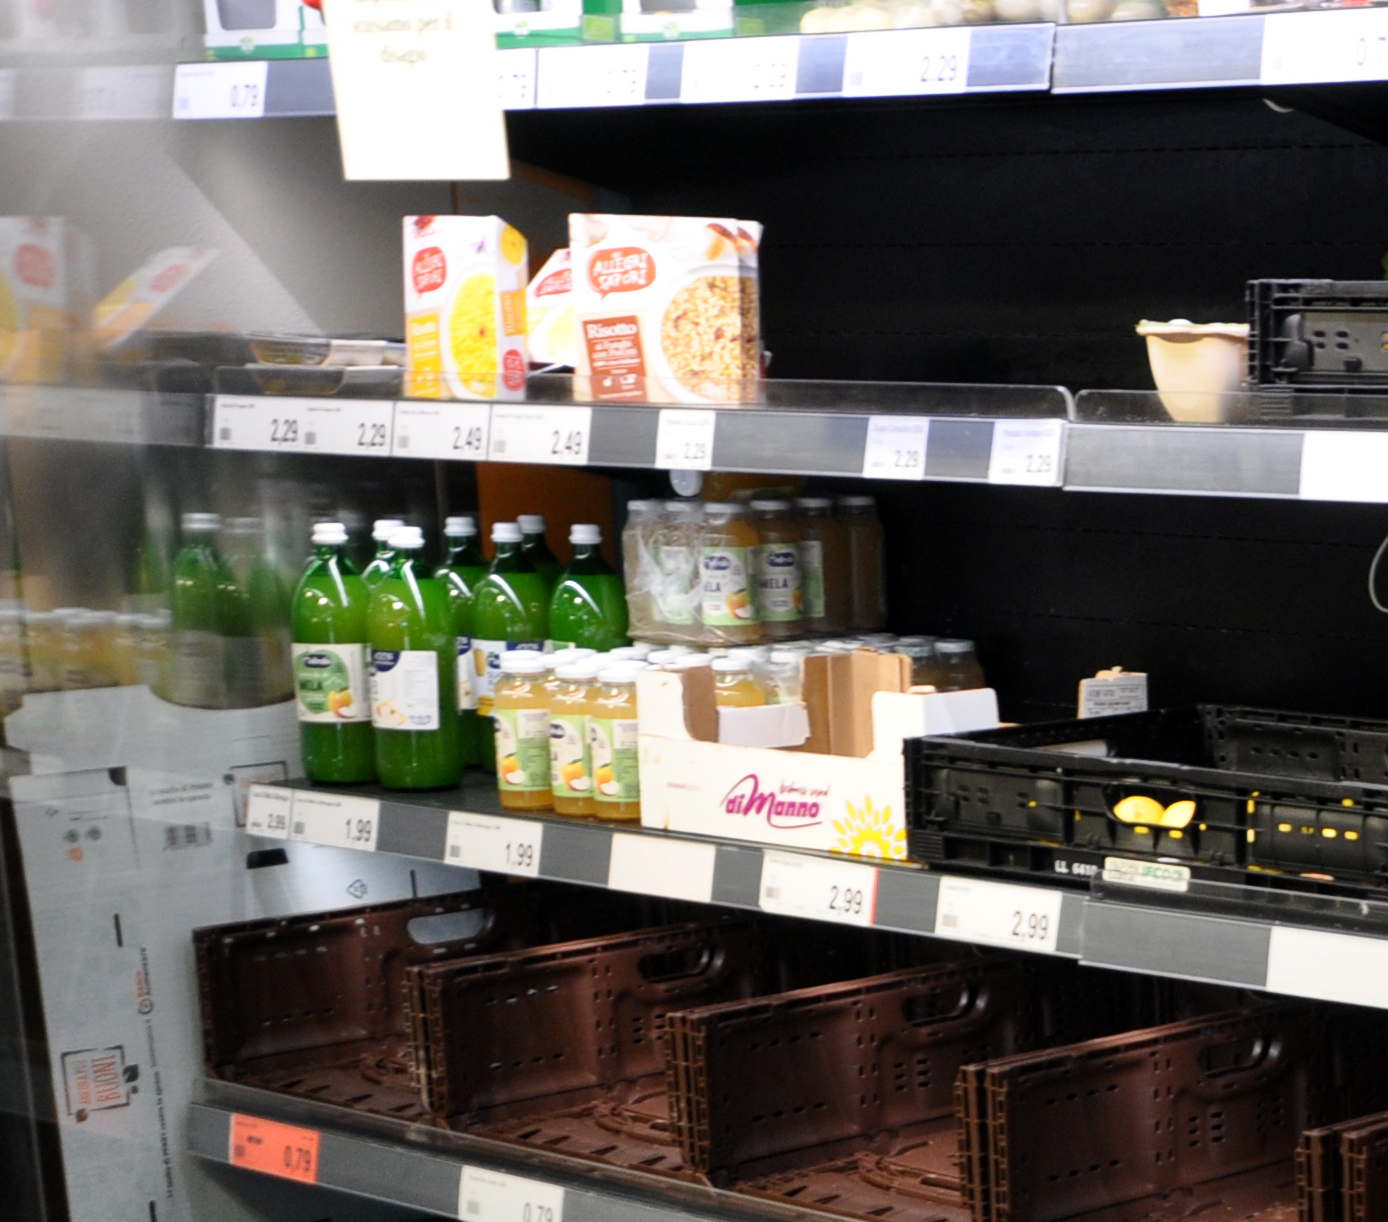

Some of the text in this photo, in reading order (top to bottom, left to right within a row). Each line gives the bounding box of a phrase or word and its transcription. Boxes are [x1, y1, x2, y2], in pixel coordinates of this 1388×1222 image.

[827, 884, 864, 916] 2,99
[1011, 909, 1050, 942] 2,99
[90, 1054, 122, 1103] BUONI
